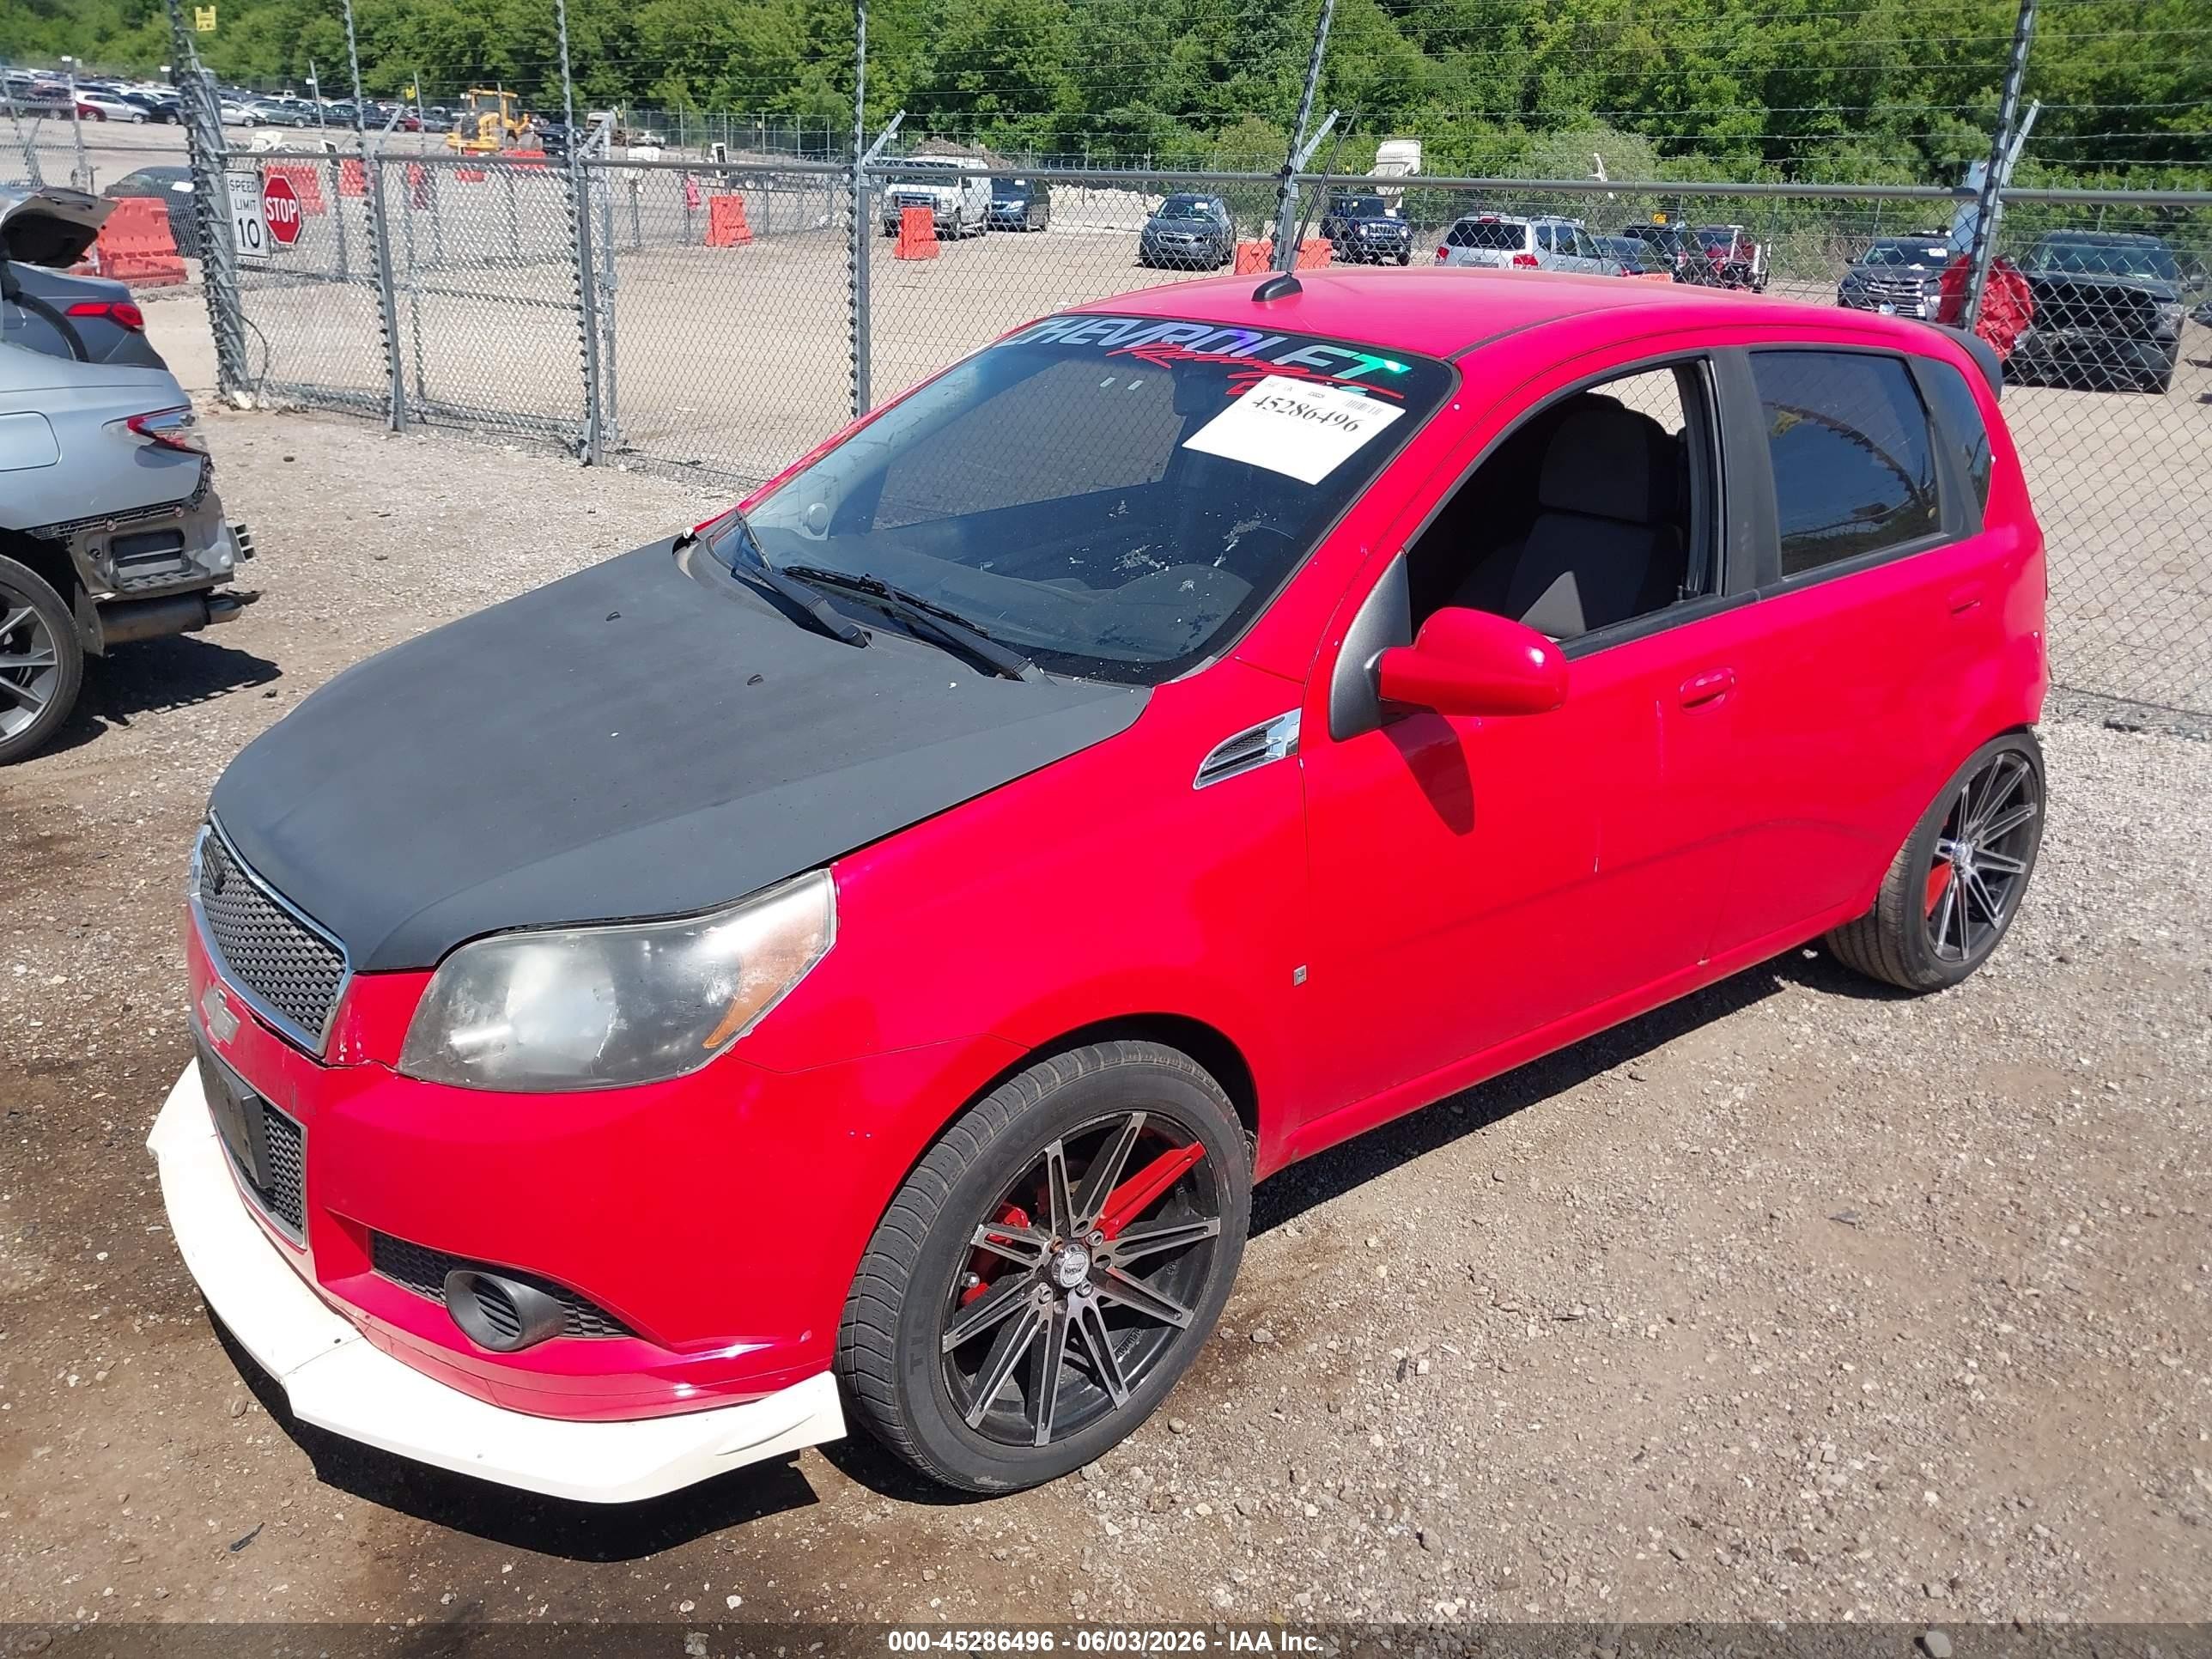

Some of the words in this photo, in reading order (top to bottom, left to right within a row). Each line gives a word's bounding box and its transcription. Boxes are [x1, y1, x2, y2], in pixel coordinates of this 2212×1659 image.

[228, 179, 256, 193] SPEED
[234, 198, 256, 211] LIMIT
[265, 197, 297, 223] STOP
[238, 217, 260, 248] 10
[993, 319, 1410, 380] CHEVROLET
[1252, 394, 1364, 433] 45286496
